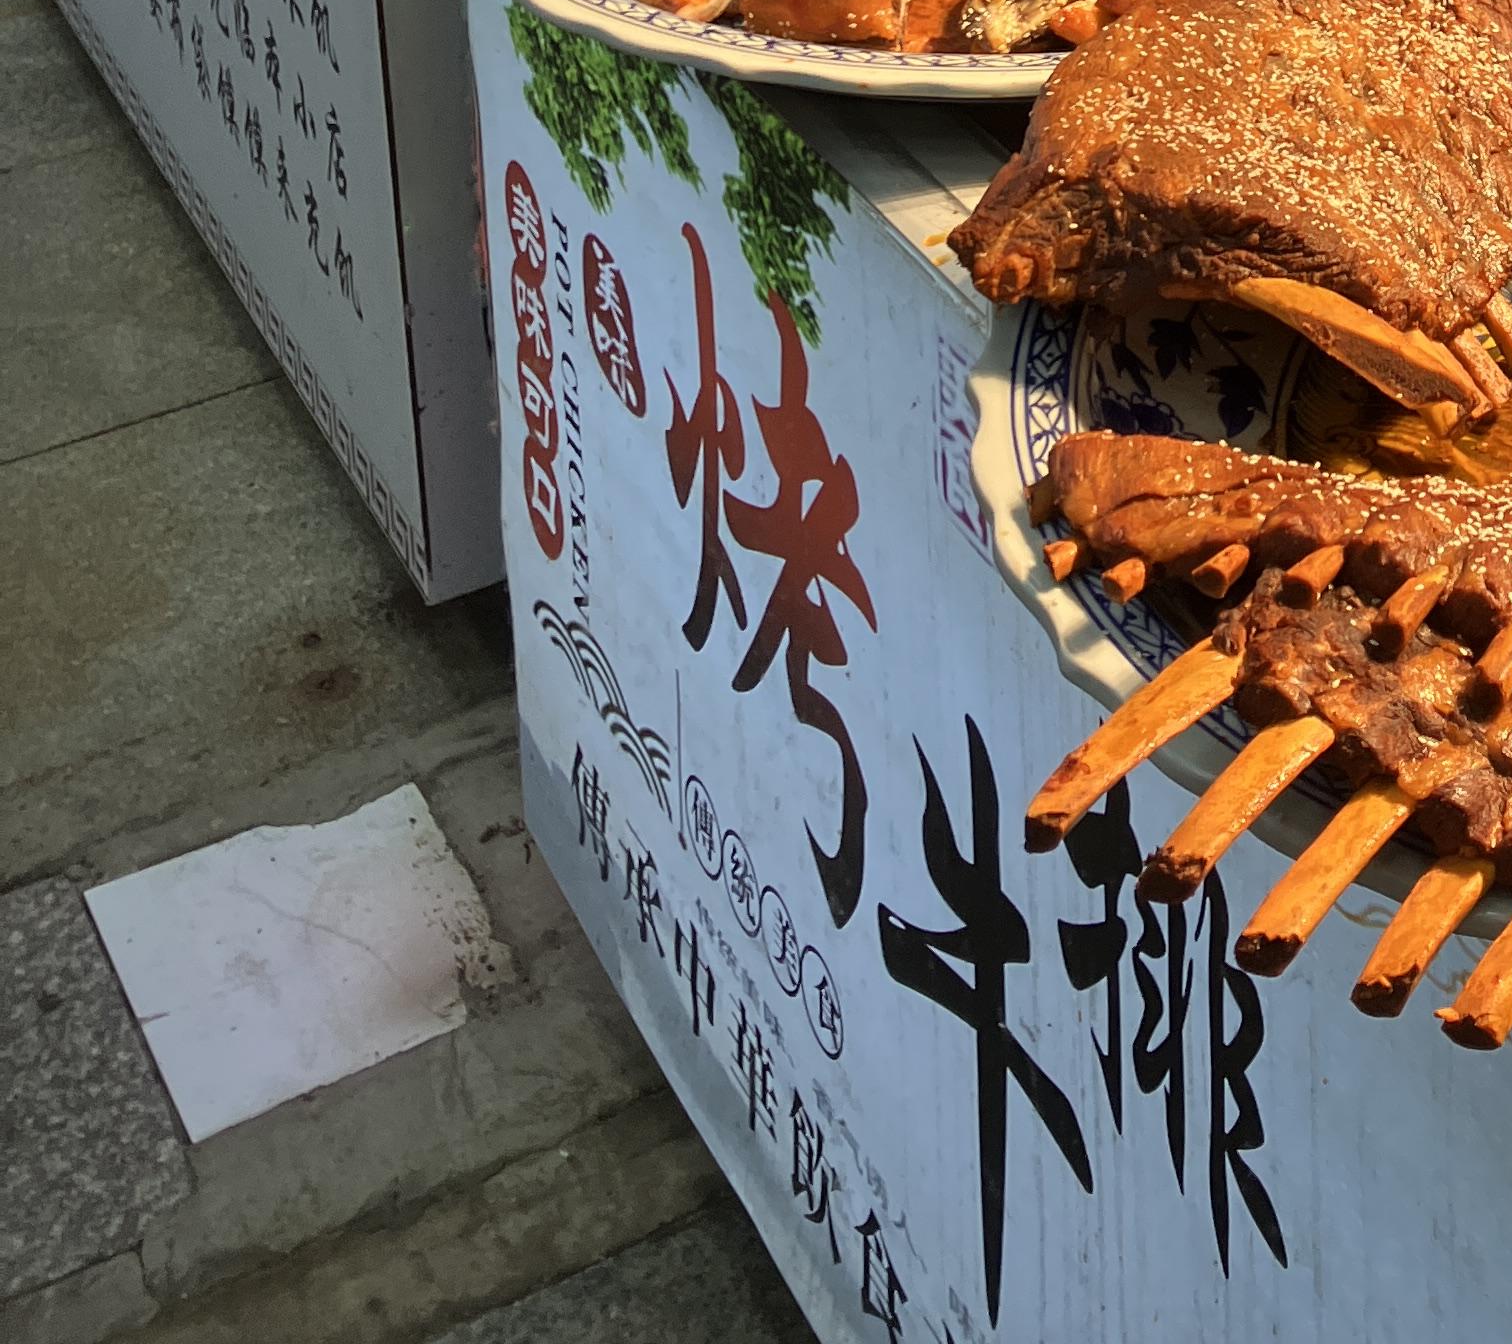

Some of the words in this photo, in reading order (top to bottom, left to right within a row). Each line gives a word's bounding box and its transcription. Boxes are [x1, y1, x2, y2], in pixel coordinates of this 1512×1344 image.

[508, 180, 560, 538] 美味可口
[550, 208, 575, 337] POT
[560, 350, 592, 630] CHICKEN
